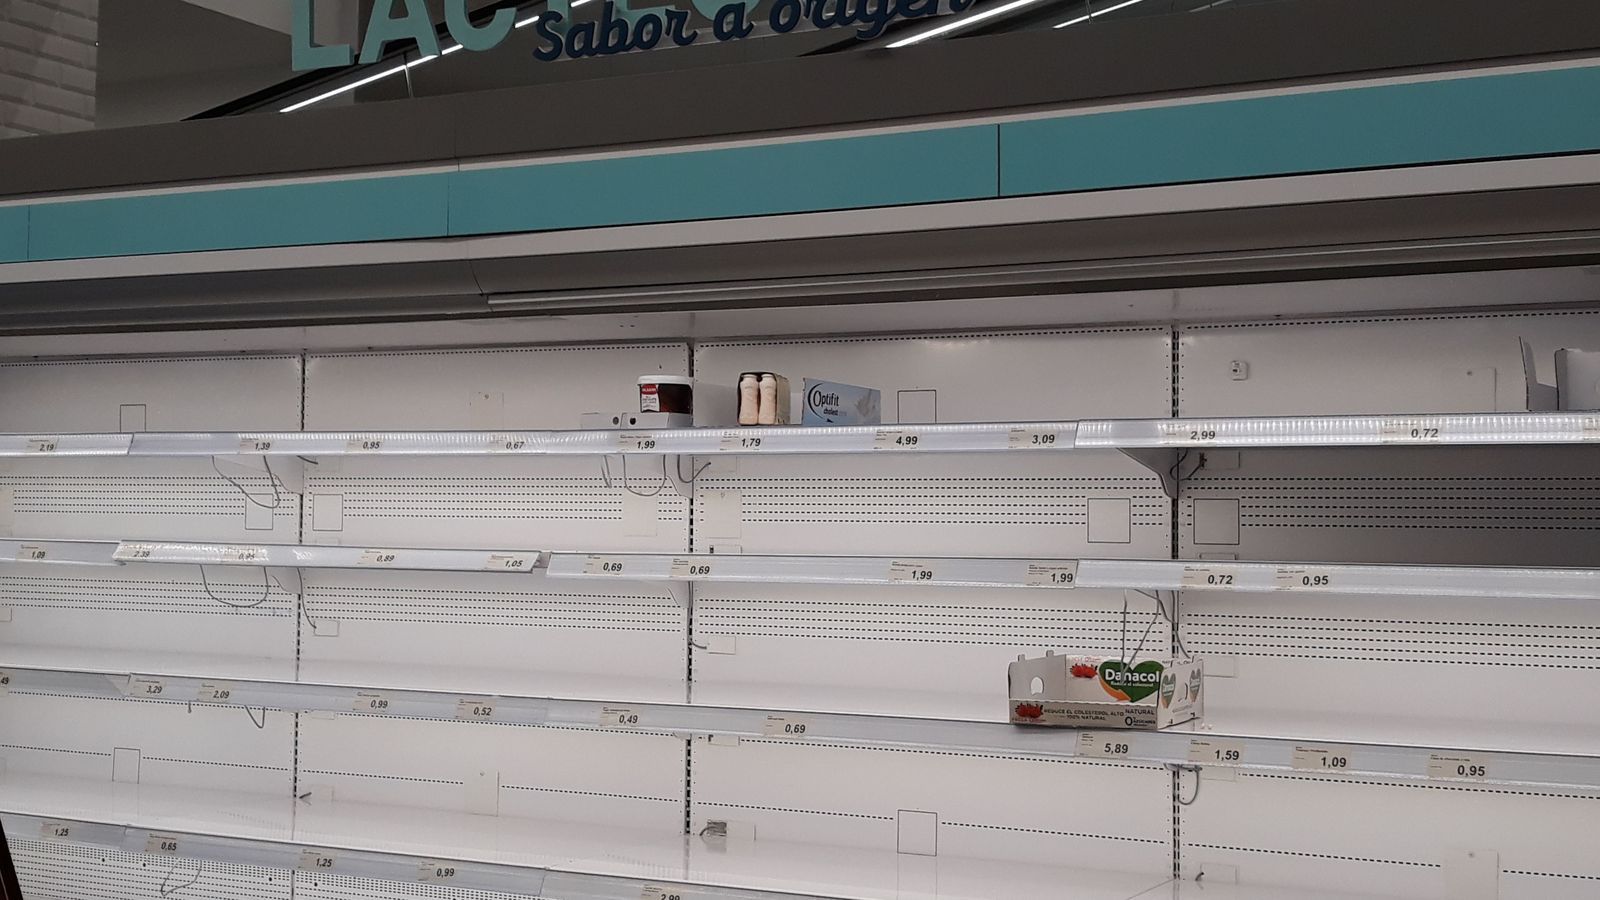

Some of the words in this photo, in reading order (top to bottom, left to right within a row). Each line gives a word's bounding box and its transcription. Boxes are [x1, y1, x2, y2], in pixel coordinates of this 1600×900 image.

[533, 1, 698, 61] Sabor
[713, 2, 754, 41] a
[813, 390, 840, 407] Optifit
[1190, 430, 1215, 441] 2,99
[1411, 428, 1438, 438] 0,72
[741, 438, 760, 448] 1,79
[895, 435, 917, 446] 4,99
[1032, 434, 1054, 445] 3,09
[39, 443, 54, 452] 2,19
[254, 442, 271, 450] 1,39
[362, 441, 380, 450] 0,95
[505, 441, 524, 450] 0,67
[637, 440, 655, 450] 1,99
[31, 551, 45, 559] 1,09
[505, 560, 522, 568] 1,05
[602, 562, 622, 572] 0,69
[689, 565, 709, 575] 0,69
[912, 570, 932, 581] 1,99
[1051, 572, 1073, 583] 1,99
[1207, 574, 1232, 585] 0,72
[1302, 575, 1328, 587] 0,95
[0, 676, 9, 685] 49
[1105, 669, 1160, 683] Danacol
[146, 685, 162, 694] 3,29
[213, 690, 229, 699] 2,09
[370, 699, 388, 709] 0,99
[473, 706, 491, 716] 0,52
[618, 714, 637, 724] 0,49
[784, 723, 805, 734] 0,69
[1104, 742, 1128, 754] 5,89
[1215, 749, 1239, 761] 1,59
[1321, 756, 1346, 768] 1,09
[1457, 764, 1484, 777] 0,95
[55, 828, 68, 837] 1,25
[160, 841, 176, 851] 0,65
[316, 858, 332, 868] 1,25
[436, 868, 454, 878] 0,99
